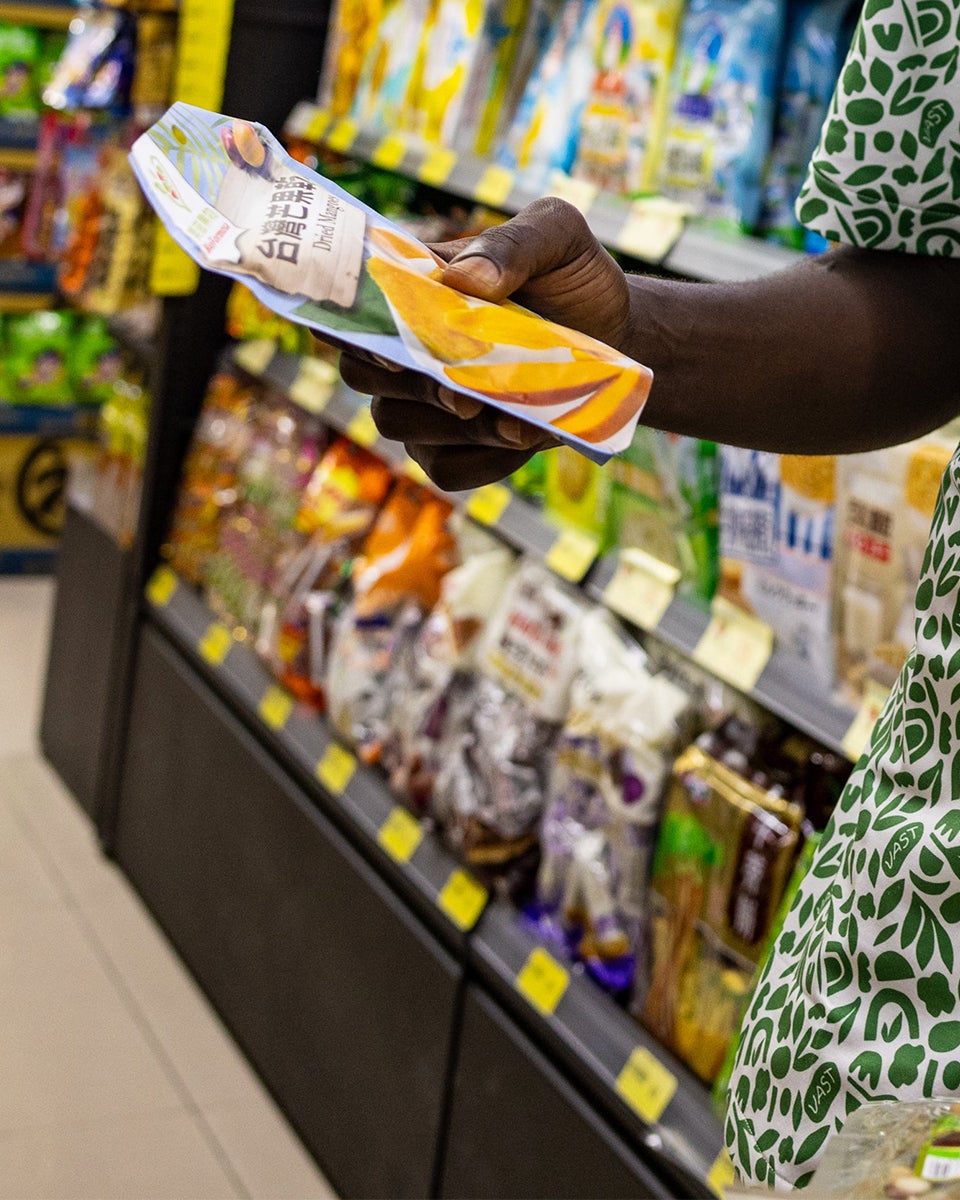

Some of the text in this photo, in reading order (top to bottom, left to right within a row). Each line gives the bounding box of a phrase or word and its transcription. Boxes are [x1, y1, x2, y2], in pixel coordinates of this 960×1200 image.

[922, 102, 949, 148] VAST
[312, 223, 335, 251] Dried
[884, 825, 919, 868] VAST
[808, 1067, 836, 1112] VAST
